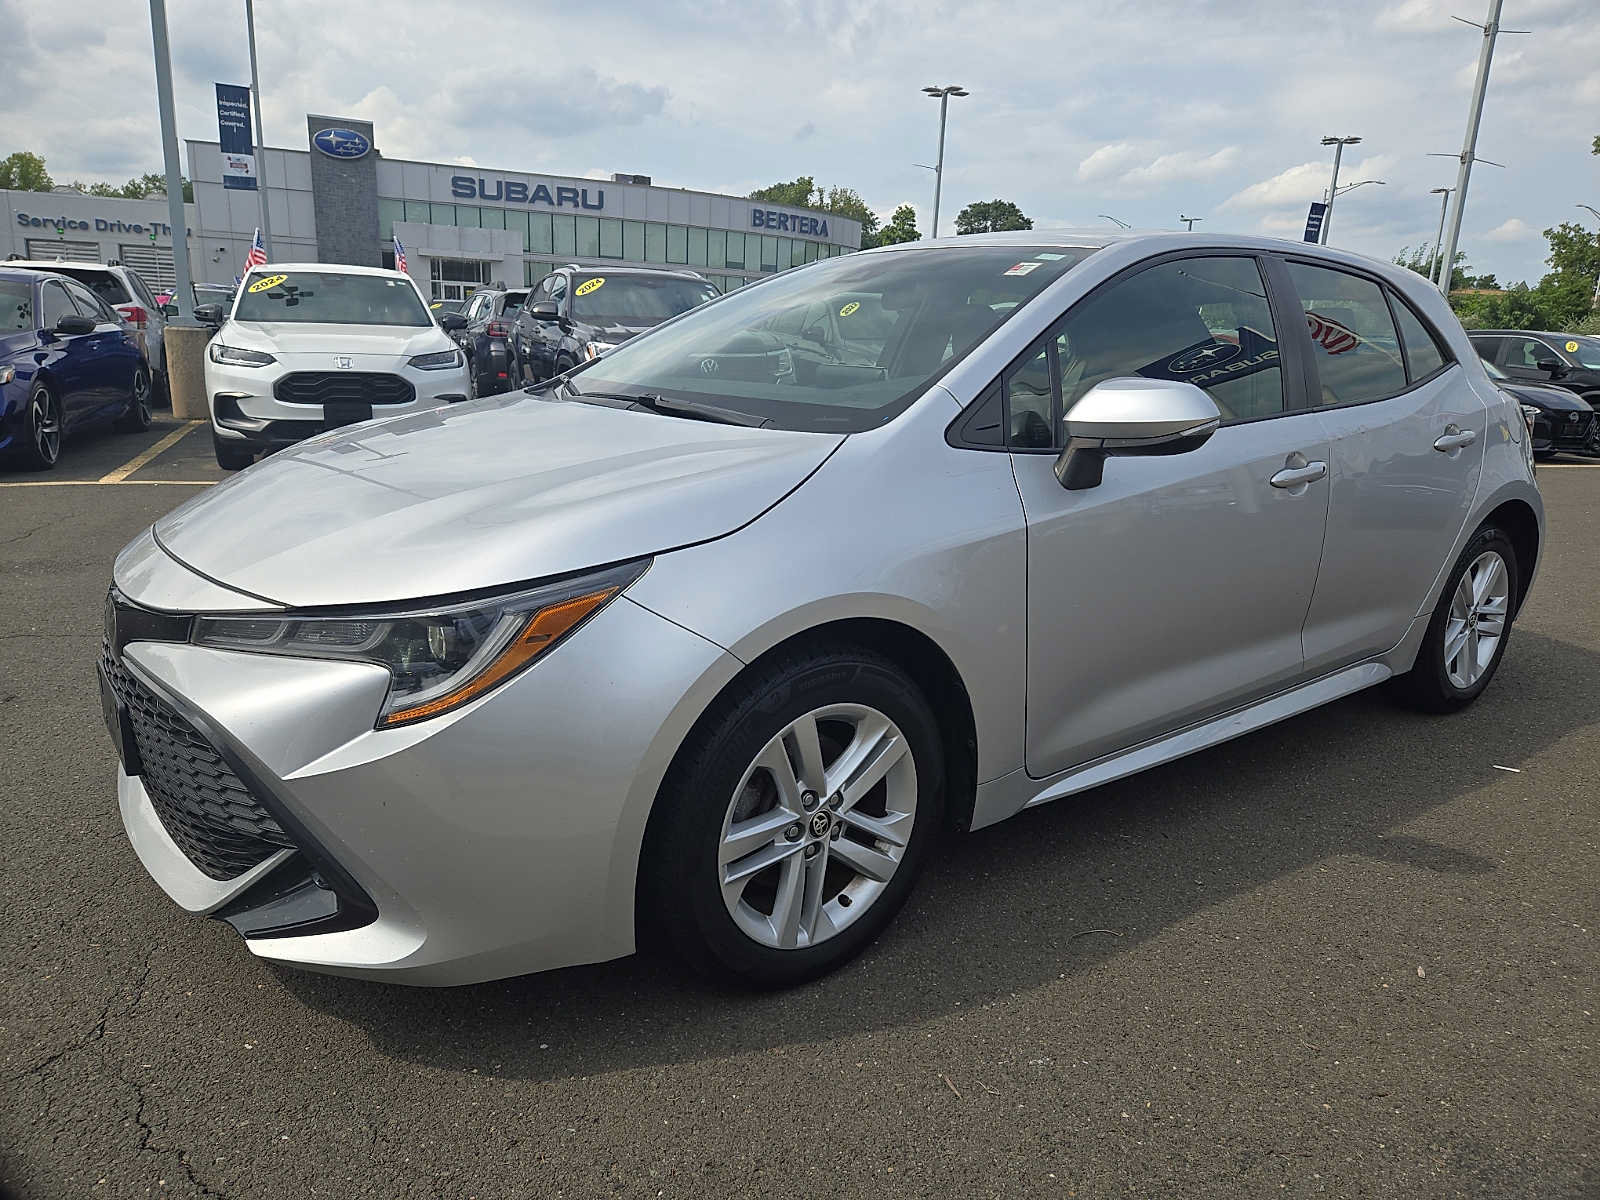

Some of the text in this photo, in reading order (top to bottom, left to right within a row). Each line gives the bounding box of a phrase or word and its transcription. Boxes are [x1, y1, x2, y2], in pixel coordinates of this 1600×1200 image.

[451, 175, 605, 211] SUBARU
[17, 213, 191, 237] Service Drive-Th
[752, 208, 829, 238] BERTERA
